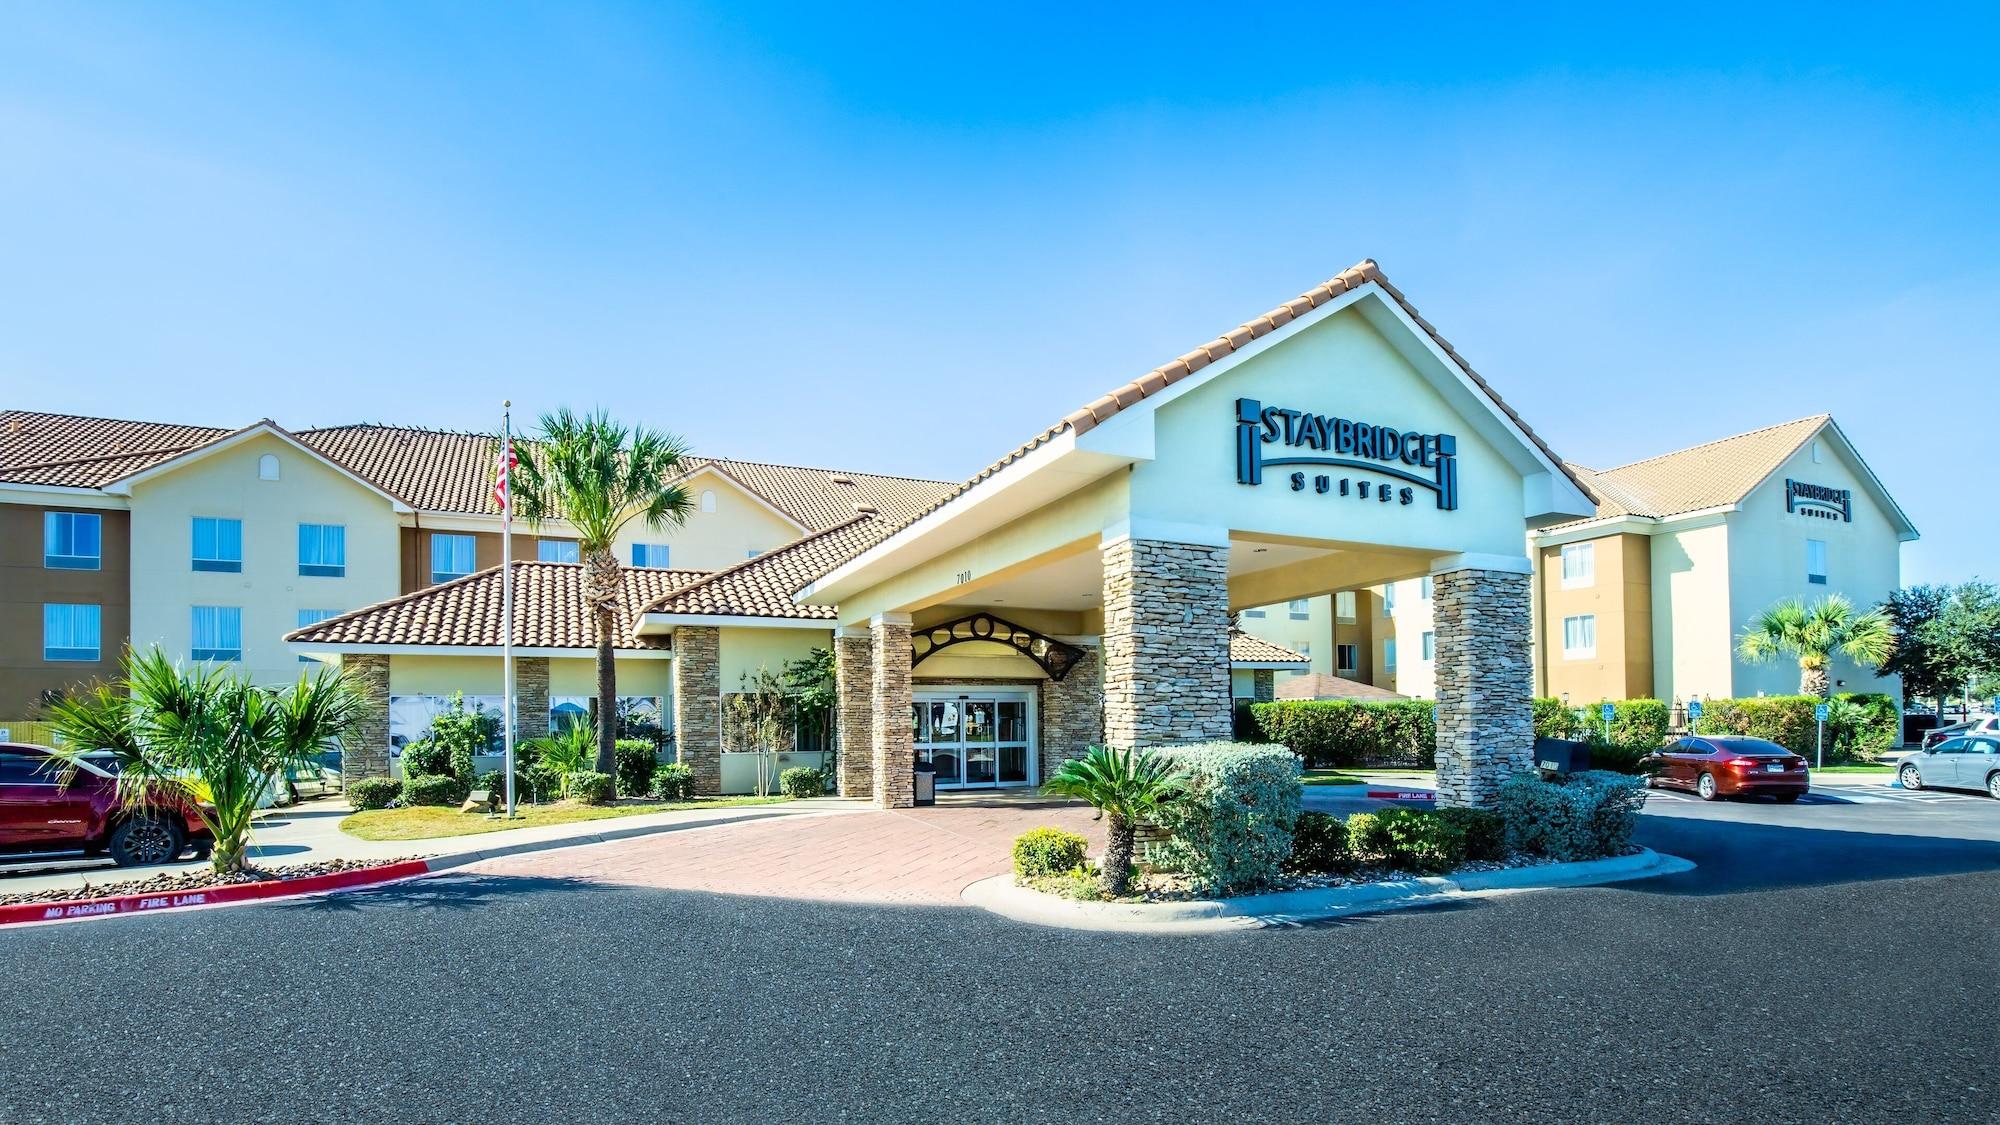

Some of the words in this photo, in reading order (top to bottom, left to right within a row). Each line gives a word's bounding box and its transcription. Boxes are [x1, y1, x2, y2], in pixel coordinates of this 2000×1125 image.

[1261, 405, 1436, 467] STAYBRIDGE
[1291, 471, 1413, 505] SUITES
[1793, 481, 1844, 504] STAYBRIDGE
[1801, 507, 1838, 520] SUITES
[957, 569, 971, 584] 7010
[44, 907, 63, 919] NO
[67, 902, 116, 916] PARKING
[139, 897, 168, 909] FIRE
[173, 894, 206, 906] LANE
